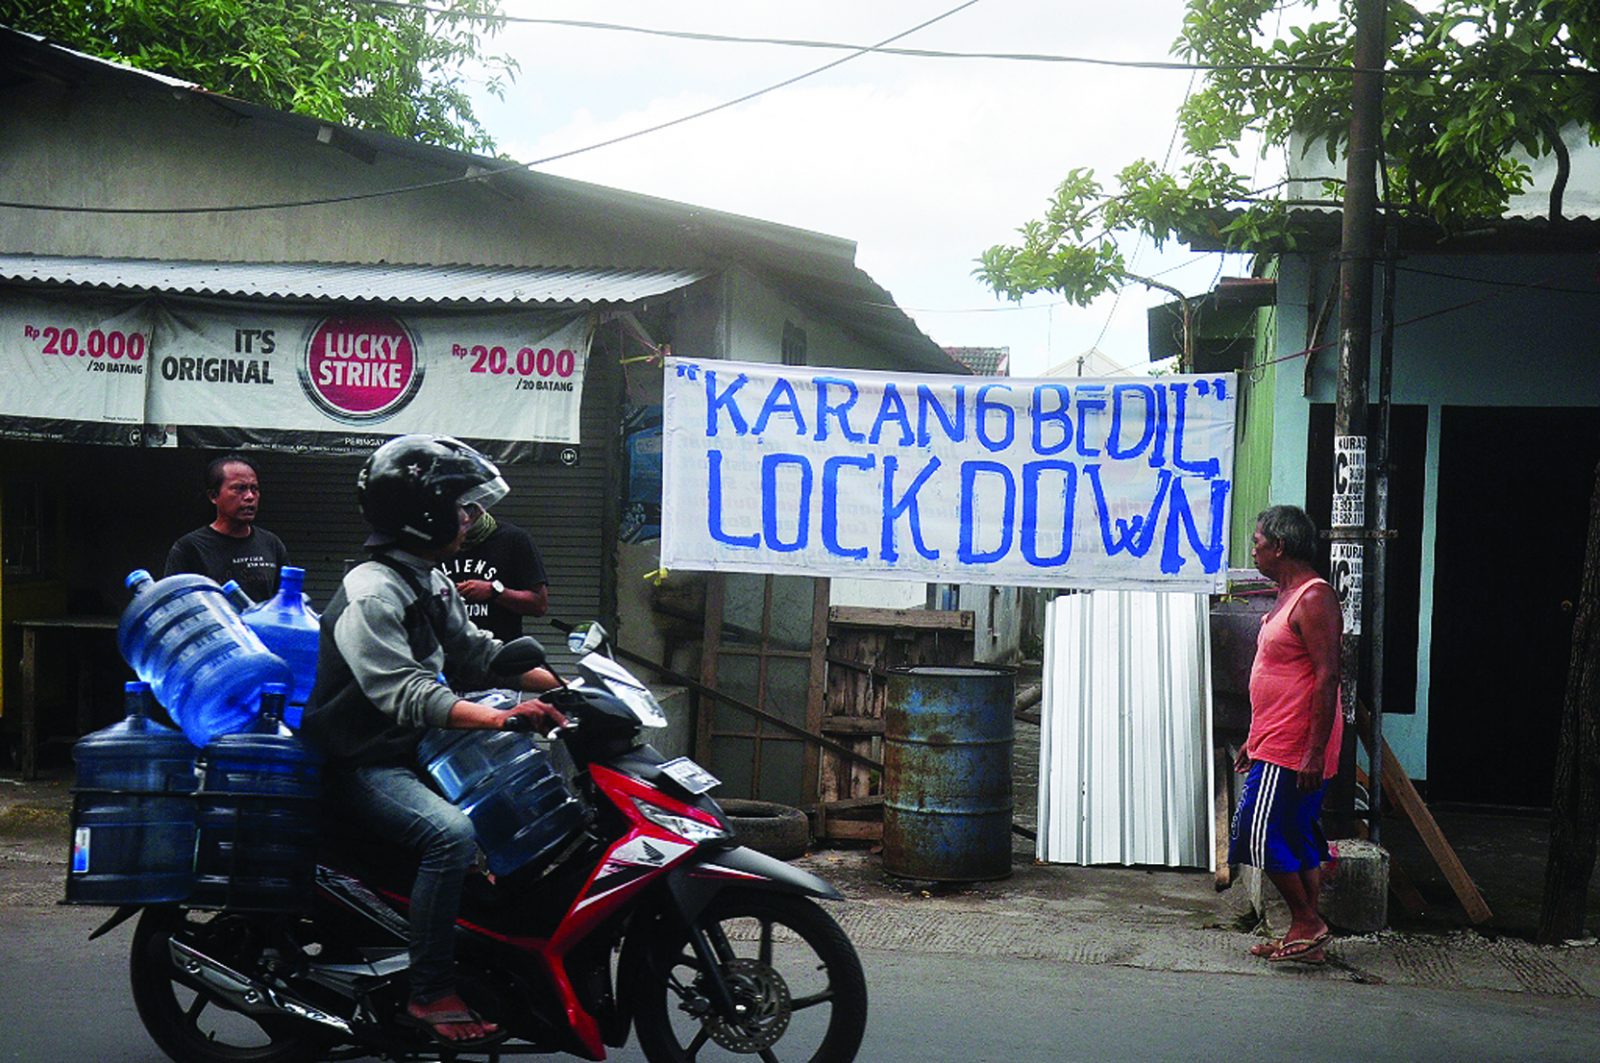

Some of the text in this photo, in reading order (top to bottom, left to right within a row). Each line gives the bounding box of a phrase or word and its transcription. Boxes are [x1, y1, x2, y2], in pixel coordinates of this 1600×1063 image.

[24, 325, 145, 361] Rp 20.000
[235, 329, 275, 354] IT'S
[325, 333, 403, 360] LUCKY
[87, 360, 143, 374] /20 BATANG
[161, 356, 274, 385] ORIGINAL
[452, 344, 575, 378] Rp 20.000
[319, 361, 402, 388] STRIKE
[515, 378, 573, 392] /20 BATANG
[344, 437, 388, 447] PERINGAT
[1340, 545, 1364, 559] KURA
[442, 558, 497, 580] LIENS
[465, 604, 489, 617] TION
